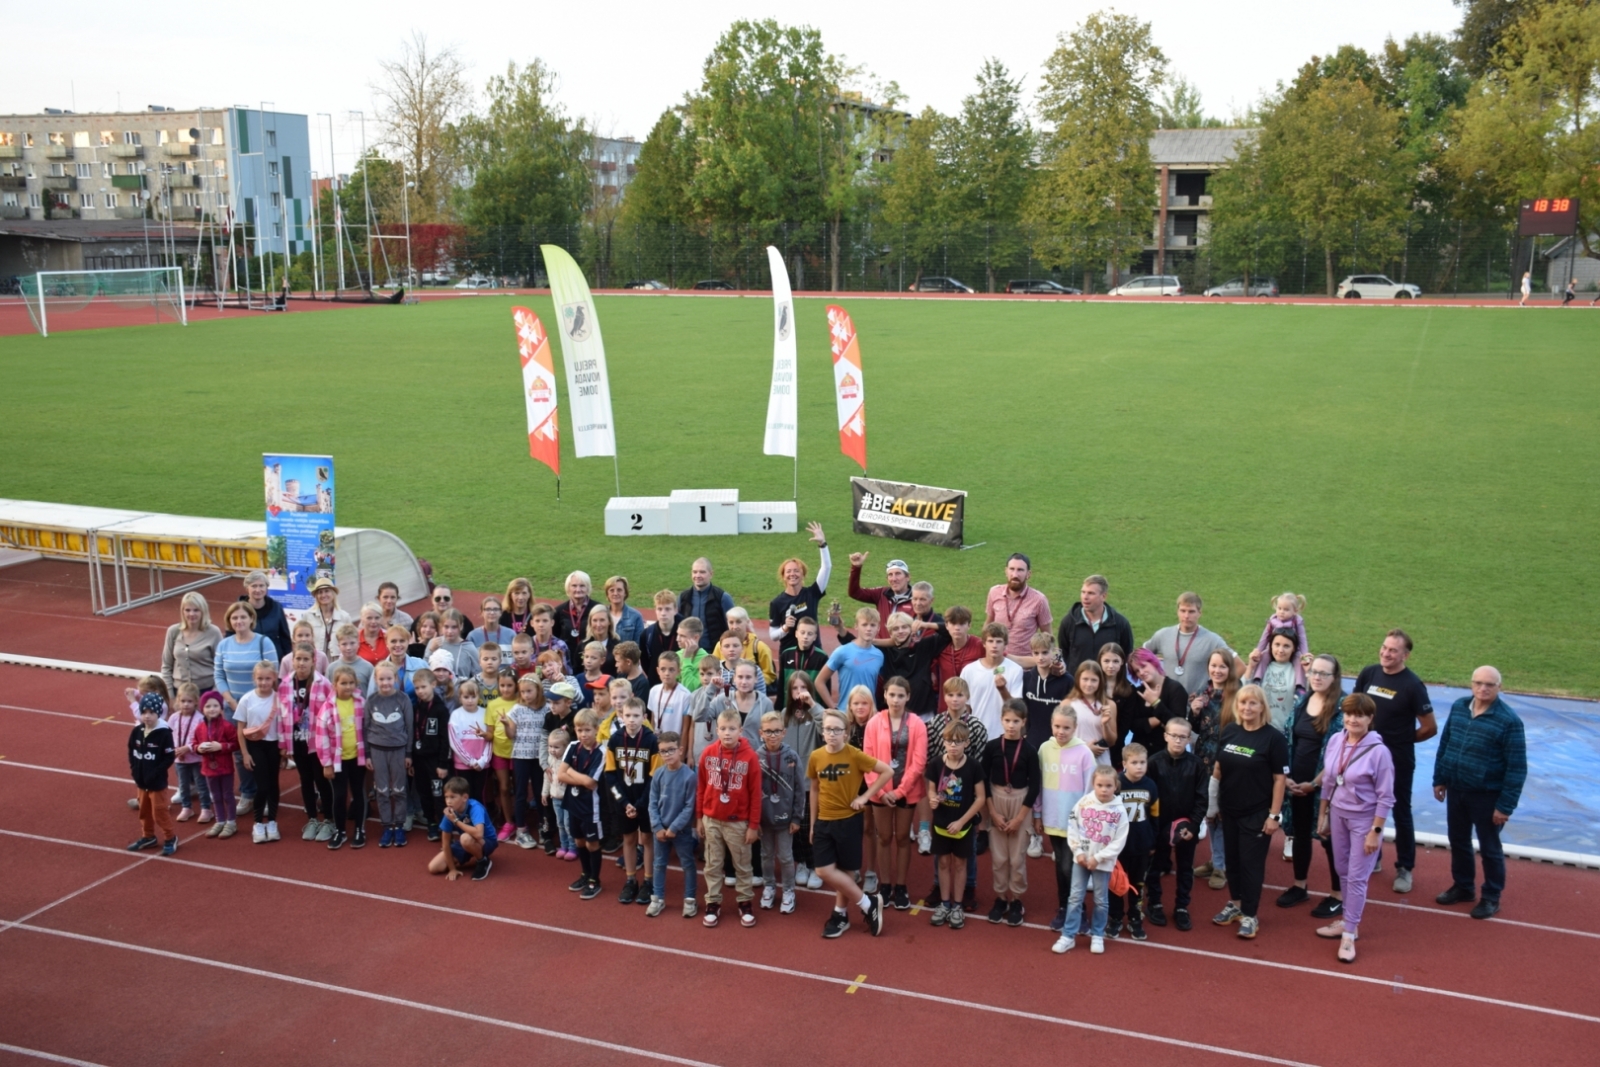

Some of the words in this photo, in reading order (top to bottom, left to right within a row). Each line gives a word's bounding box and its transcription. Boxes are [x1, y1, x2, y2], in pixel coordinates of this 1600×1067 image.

[1533, 199, 1549, 213] 18
[1551, 199, 1570, 213] 38
[699, 505, 707, 522] 1
[860, 491, 957, 521] #BEACTIVE
[631, 513, 643, 531] 2
[762, 516, 773, 531] 3
[1044, 763, 1078, 775] LOVE
